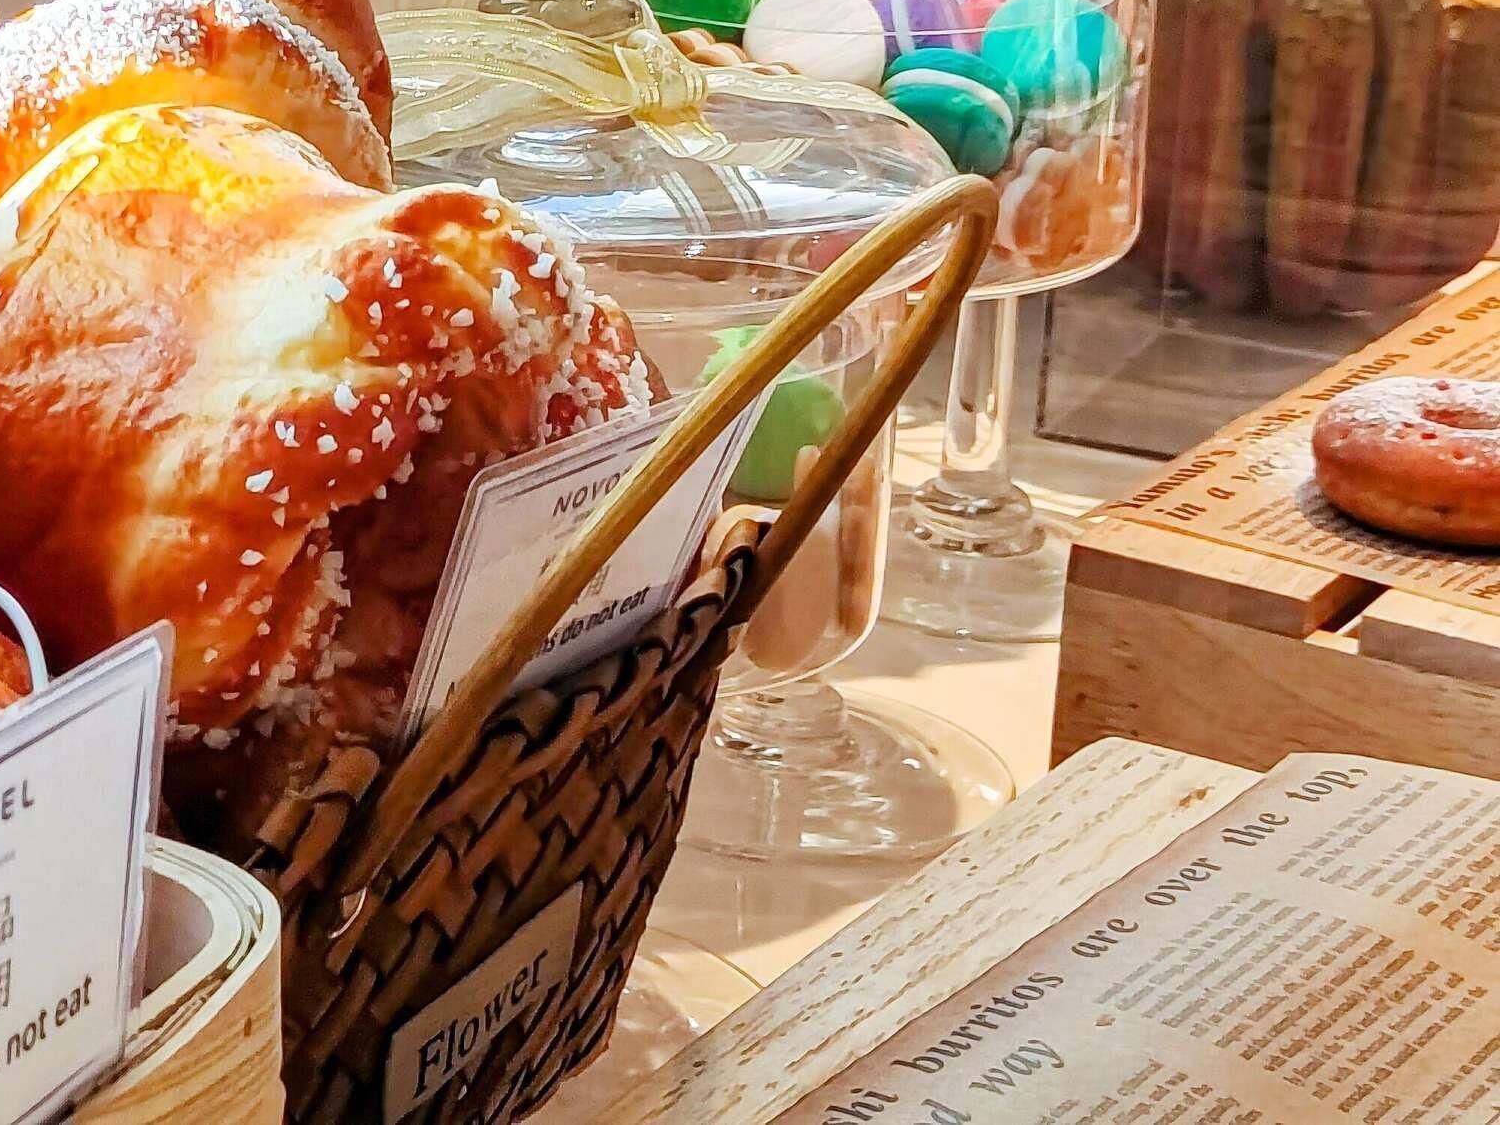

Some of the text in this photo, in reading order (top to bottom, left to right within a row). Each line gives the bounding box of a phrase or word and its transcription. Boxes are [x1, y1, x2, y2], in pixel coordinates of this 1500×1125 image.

[1300, 353, 1409, 401] burritos
[1411, 325, 1456, 346] are
[551, 465, 632, 517] NOVO
[1153, 502, 1208, 521] in
[1206, 486, 1236, 500] a
[585, 599, 618, 631] not
[619, 585, 652, 615] eat
[890, 974, 1064, 1074] burritos
[1070, 917, 1140, 958] are
[1144, 857, 1222, 906] over
[1220, 812, 1290, 847] the
[1284, 767, 1369, 803] top,
[6, 1008, 48, 1066] not
[54, 973, 93, 1027] eat
[412, 947, 549, 1100] Flower
[968, 1038, 1066, 1095] way
